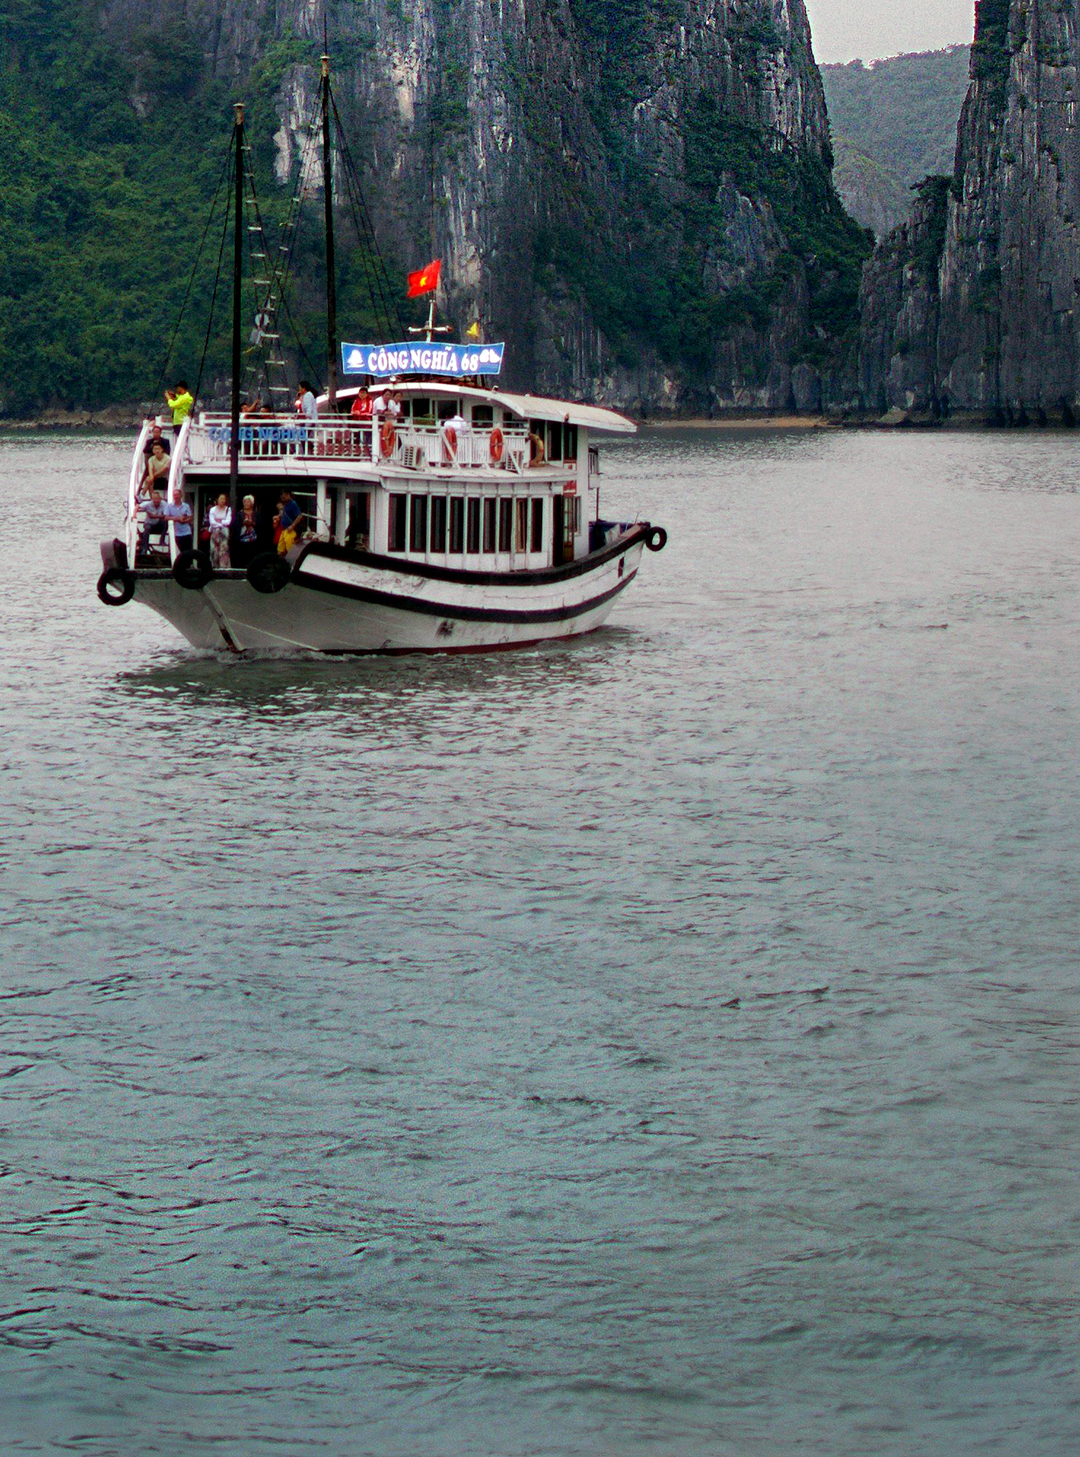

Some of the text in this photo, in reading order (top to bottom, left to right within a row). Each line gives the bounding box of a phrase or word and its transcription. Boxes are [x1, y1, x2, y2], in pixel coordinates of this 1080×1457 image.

[367, 346, 479, 372] CÔNG NGHĨA 68
